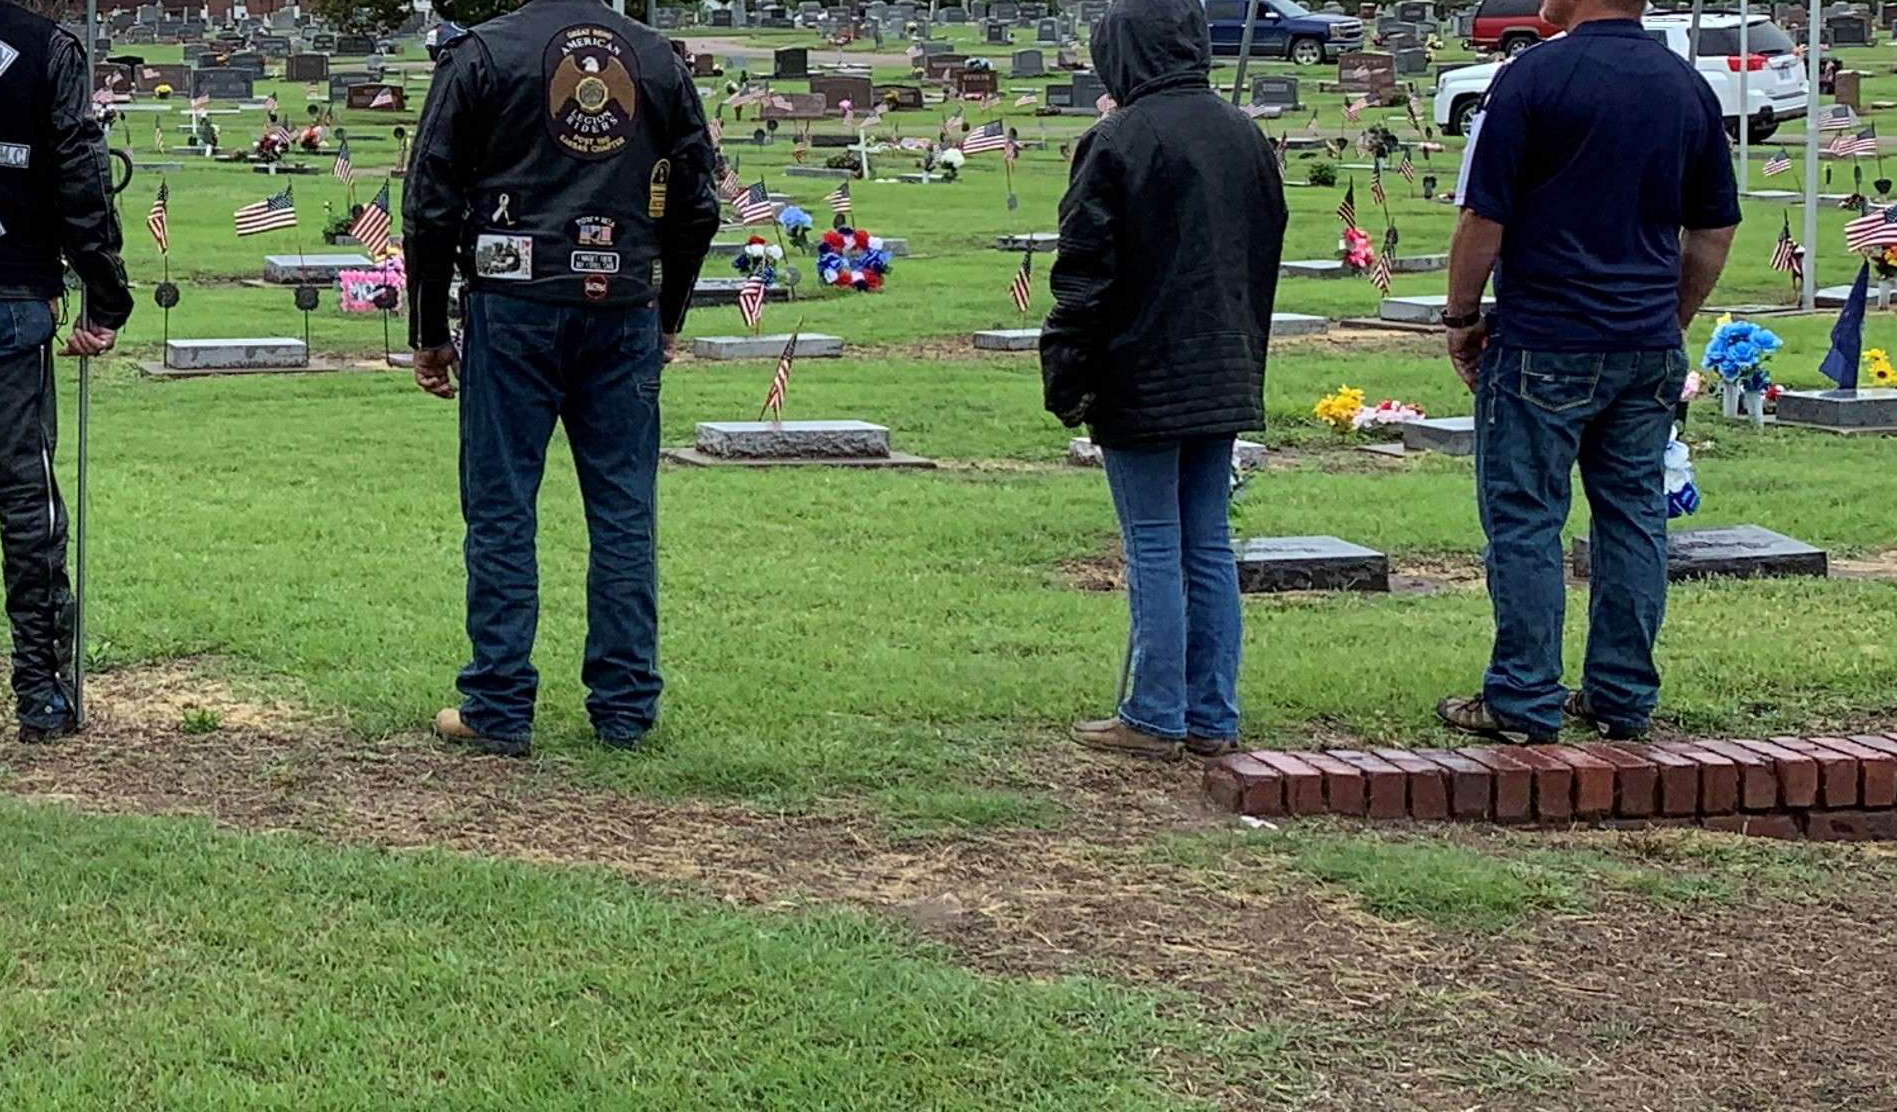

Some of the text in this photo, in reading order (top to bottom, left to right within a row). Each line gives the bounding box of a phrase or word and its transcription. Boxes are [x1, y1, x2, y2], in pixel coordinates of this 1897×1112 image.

[561, 37, 622, 56] AMERICAN
[565, 115, 619, 134] RIDERS
[570, 108, 612, 126] LEGION
